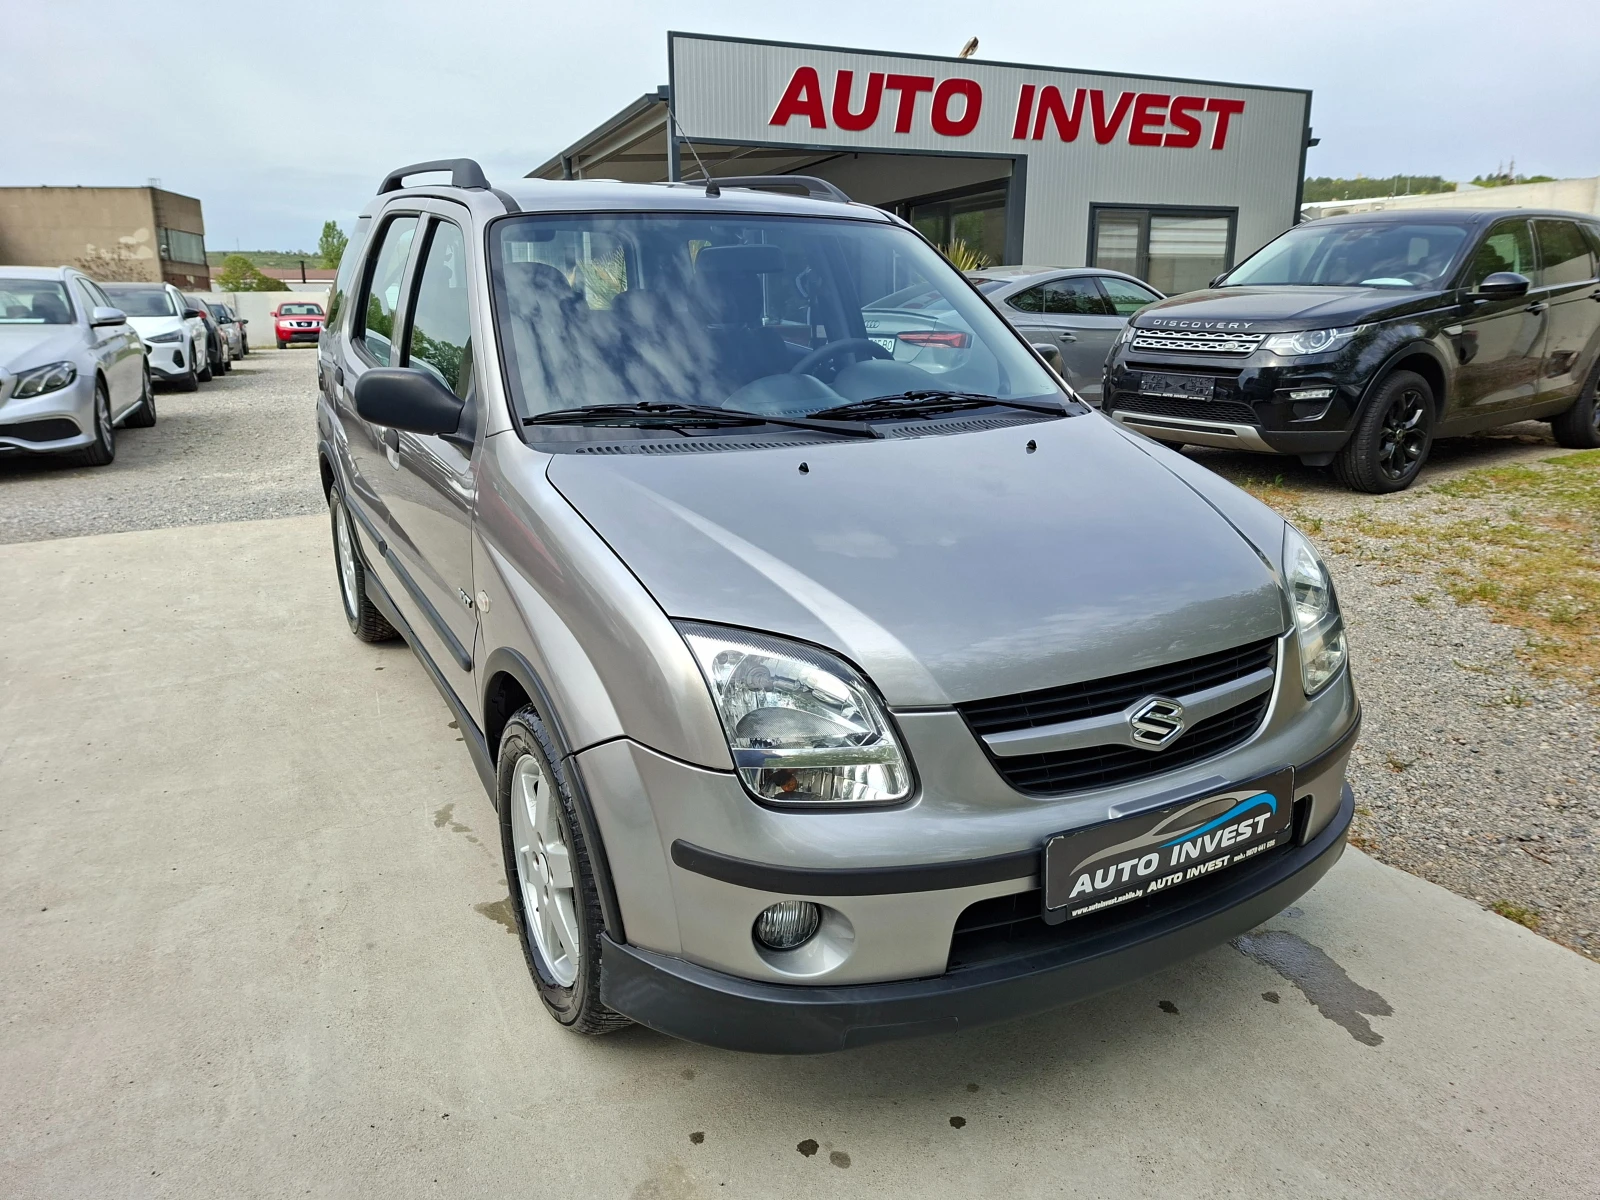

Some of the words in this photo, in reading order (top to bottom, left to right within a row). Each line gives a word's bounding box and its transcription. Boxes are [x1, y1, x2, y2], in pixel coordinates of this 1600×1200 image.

[767, 66, 983, 136] AUTO
[1012, 84, 1246, 150] INVEST
[1153, 319, 1253, 329] DISCOVERY
[1069, 853, 1159, 898] AUTO
[1170, 812, 1271, 866] INVEST
[1147, 872, 1183, 893] AUTO
[1186, 855, 1231, 880] INVEST
